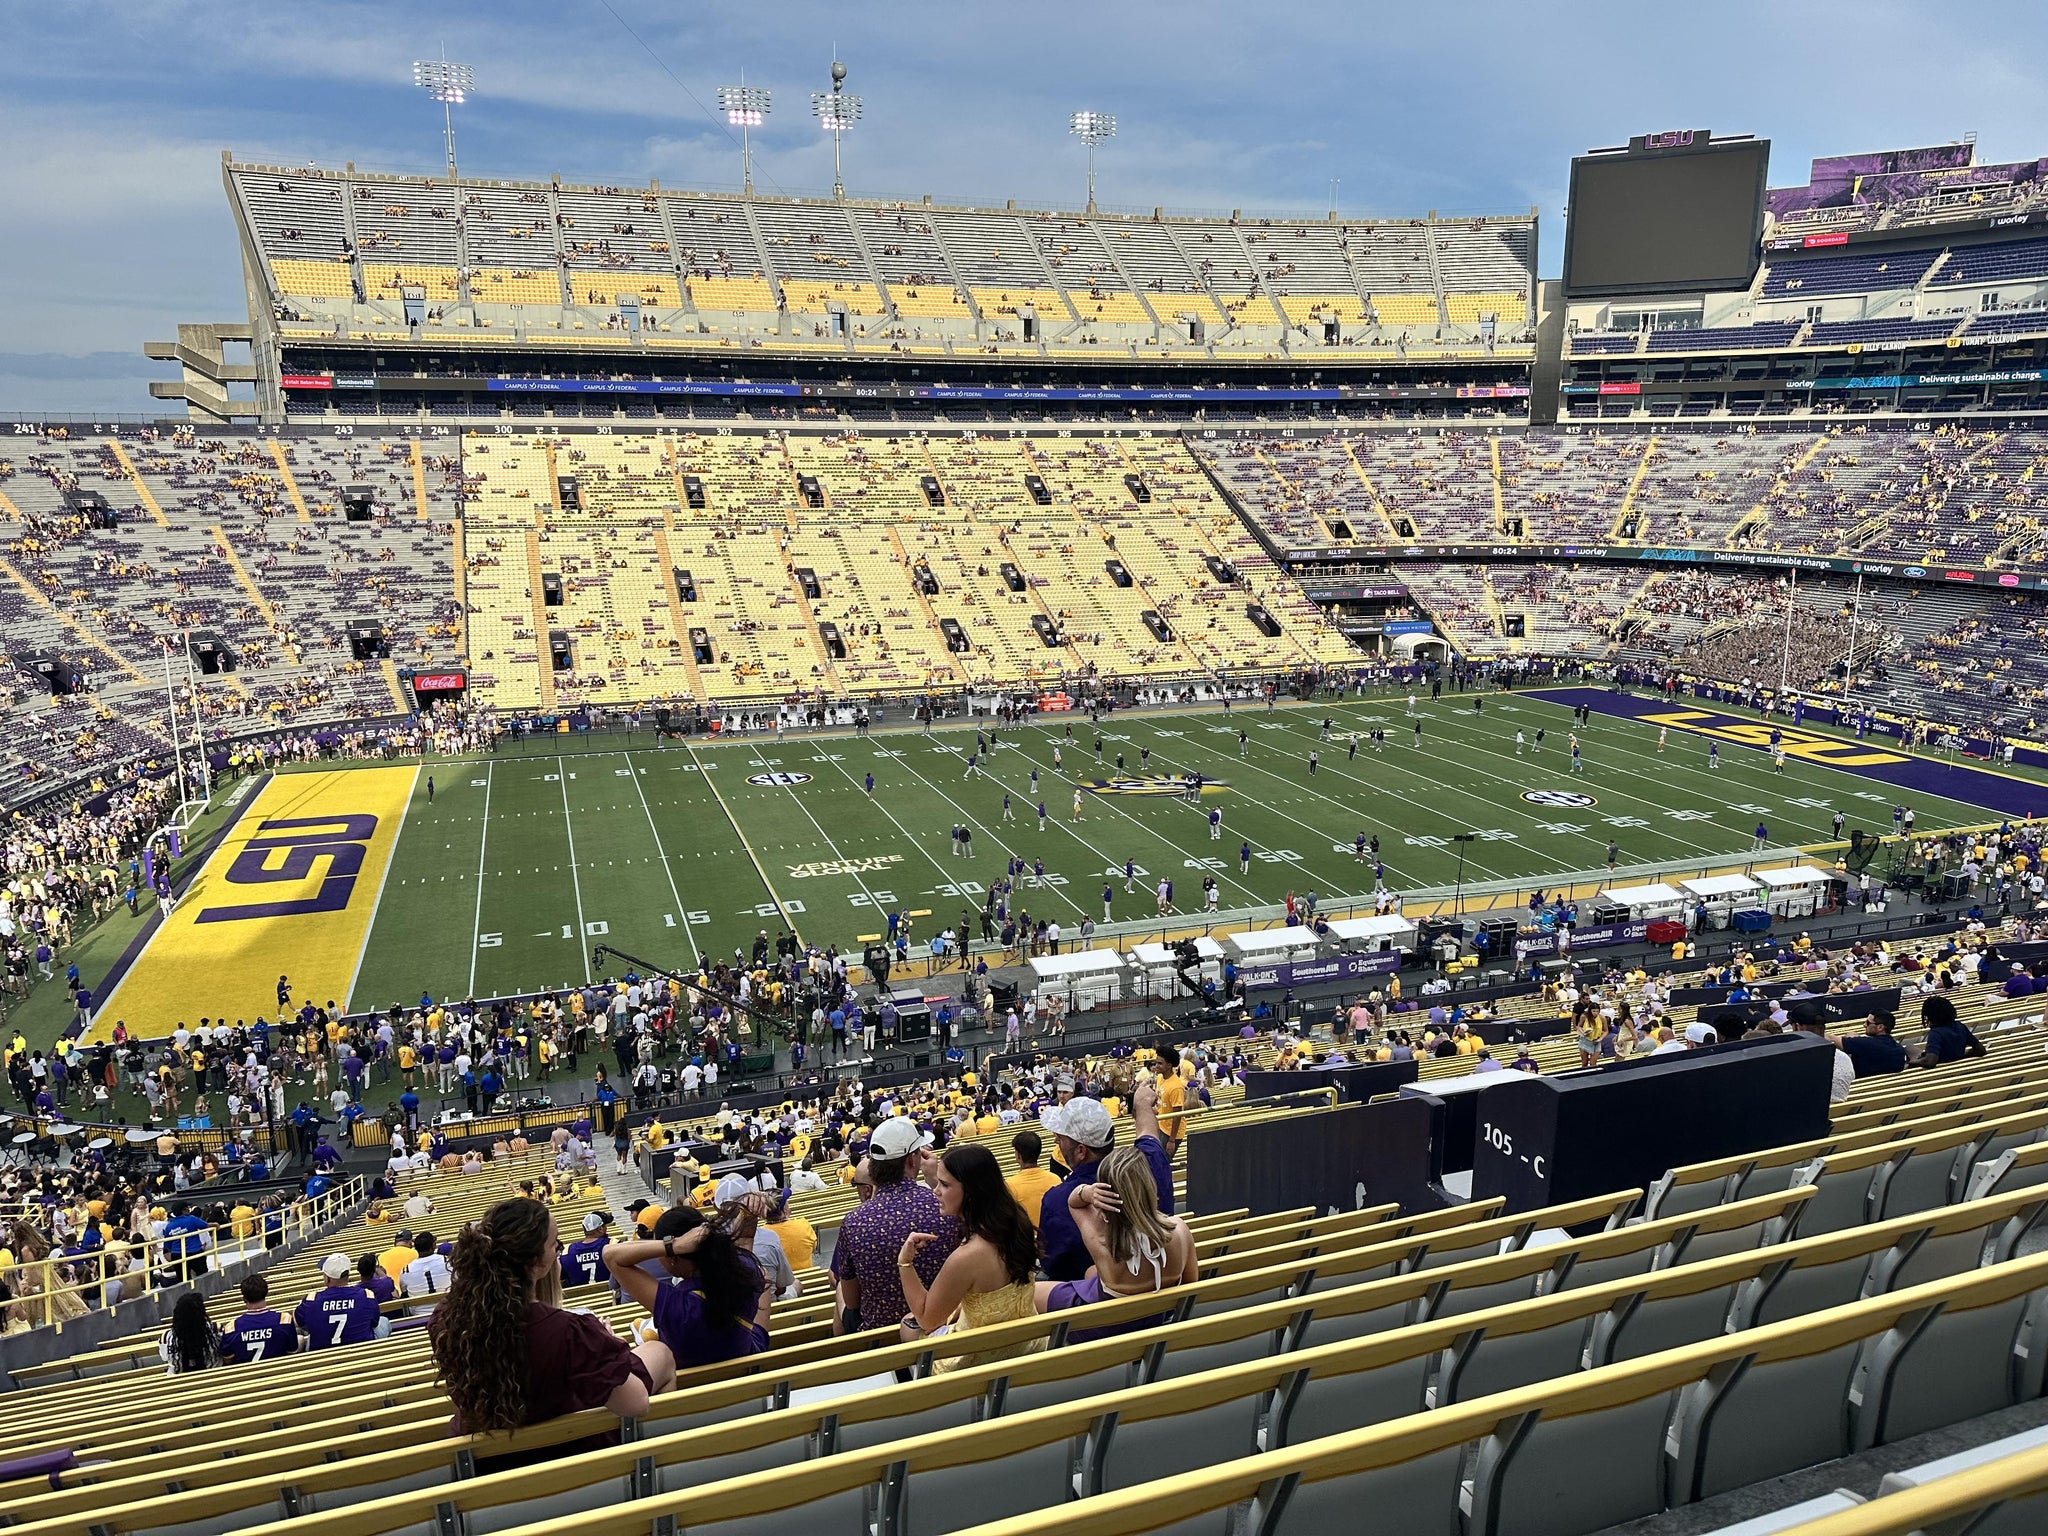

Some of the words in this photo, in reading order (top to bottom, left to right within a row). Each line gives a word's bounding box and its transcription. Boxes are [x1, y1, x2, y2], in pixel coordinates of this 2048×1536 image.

[1644, 129, 1694, 150] LSU
[1997, 214, 2029, 225] worley
[1786, 380, 1816, 389] worley
[1919, 375, 1960, 384] Delivering
[1961, 372, 2009, 382] sustainable
[2011, 372, 2042, 381] change.
[856, 388, 877, 396] 80:24
[14, 424, 36, 434] 241
[334, 426, 354, 435] 243
[430, 426, 450, 435] 244
[494, 426, 513, 434] 300
[596, 426, 613, 434] 301
[716, 428, 733, 436] 302
[962, 430, 977, 438] 304
[1566, 426, 1580, 434] 413
[1914, 423, 1930, 432] 415
[1577, 548, 1608, 556] worley
[1714, 553, 1755, 564] Delivering
[1756, 555, 1802, 566] sustainable
[1802, 558, 1832, 570] change.
[1864, 564, 1893, 574] worley
[420, 676, 457, 689] Coca-Cola
[1635, 711, 1912, 766] LSU
[751, 772, 808, 786] SEC
[1662, 809, 1714, 821] 20
[1726, 804, 1773, 814] 15
[1403, 835, 1449, 848] 40
[785, 854, 904, 871] VENTURE
[1184, 856, 1229, 870] 45
[1253, 850, 1304, 864] 50
[194, 814, 378, 924] LSU
[790, 864, 892, 878] GLOBAL
[1105, 864, 1151, 878] 40
[934, 881, 986, 898] 30
[846, 890, 900, 906] 25
[754, 900, 807, 917] 20
[664, 910, 711, 928] 15
[561, 920, 610, 939] 10
[1570, 930, 1613, 942] SouthernAIR
[479, 932, 503, 948] 5
[1524, 936, 1552, 948] ALK-ON'S
[1358, 956, 1394, 967] Equipment
[1292, 964, 1340, 977] SouthernAIR
[1358, 964, 1378, 974] Share
[662, 1074, 671, 1083] 12
[438, 1136, 444, 1146] 7
[799, 1140, 806, 1150] 3
[1483, 1122, 1513, 1156] 105
[576, 1252, 600, 1263] WEEKS
[582, 1262, 596, 1284] 7
[424, 1270, 434, 1292] 1
[322, 1298, 356, 1312] GREEN
[240, 1328, 273, 1342] WEEKS
[328, 1314, 348, 1345] 7
[246, 1342, 266, 1362] 7
